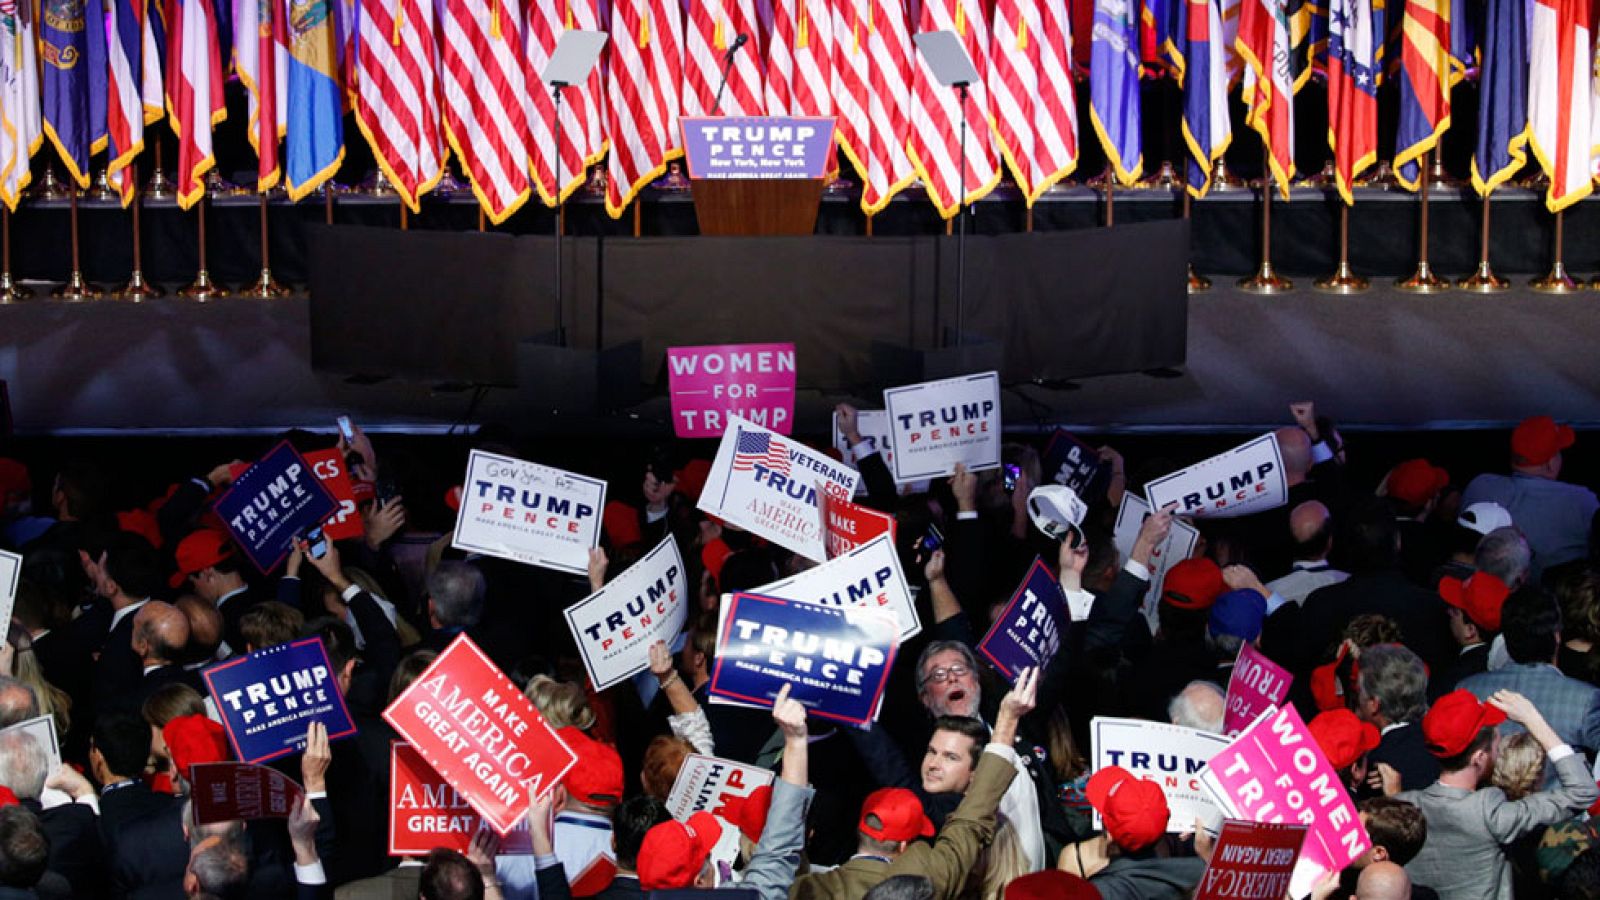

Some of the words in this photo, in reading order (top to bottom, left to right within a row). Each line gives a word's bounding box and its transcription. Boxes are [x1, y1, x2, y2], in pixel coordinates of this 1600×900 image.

[701, 126, 816, 142] TRUMP
[710, 144, 806, 156] PENCE
[710, 158, 731, 167] New
[734, 158, 758, 168] York,
[760, 158, 782, 167] New
[784, 158, 806, 167] York
[670, 351, 796, 376] WOMEN
[713, 383, 757, 399] FOR
[897, 400, 994, 431] TRUMP
[910, 420, 989, 444] PENCE
[312, 458, 340, 480] CS
[788, 448, 854, 488] VETERANS
[231, 463, 302, 534] TRUMP
[475, 479, 594, 520] TRUMP
[824, 480, 849, 498] FOR
[247, 483, 306, 542] PENCE
[481, 502, 581, 534] PENCE
[746, 497, 824, 542] AMERICA
[584, 564, 678, 641] TRUMP
[602, 589, 677, 650] PENCE
[735, 618, 885, 669] TRUMP
[735, 660, 761, 673] MAKE
[761, 667, 801, 683] AMERICA
[802, 677, 831, 690] GREAT
[742, 643, 864, 686] PENCE
[222, 665, 329, 711] TRUMP
[241, 688, 328, 724] PENCE
[245, 723, 267, 736] MAKE
[267, 713, 298, 728] AMERICA
[421, 671, 544, 790] AMERICA
[481, 687, 529, 738] MAKE
[413, 700, 470, 755] GREAT
[463, 751, 521, 808] AGAIN
[692, 763, 725, 811] WITH
[1271, 709, 1367, 859] WOMEN
[1274, 772, 1315, 827] FOR
[407, 814, 473, 833] GREAT
[1220, 843, 1263, 865] AGAIN
[1261, 847, 1295, 866] GREAT
[1205, 868, 1291, 898] AMERICA
